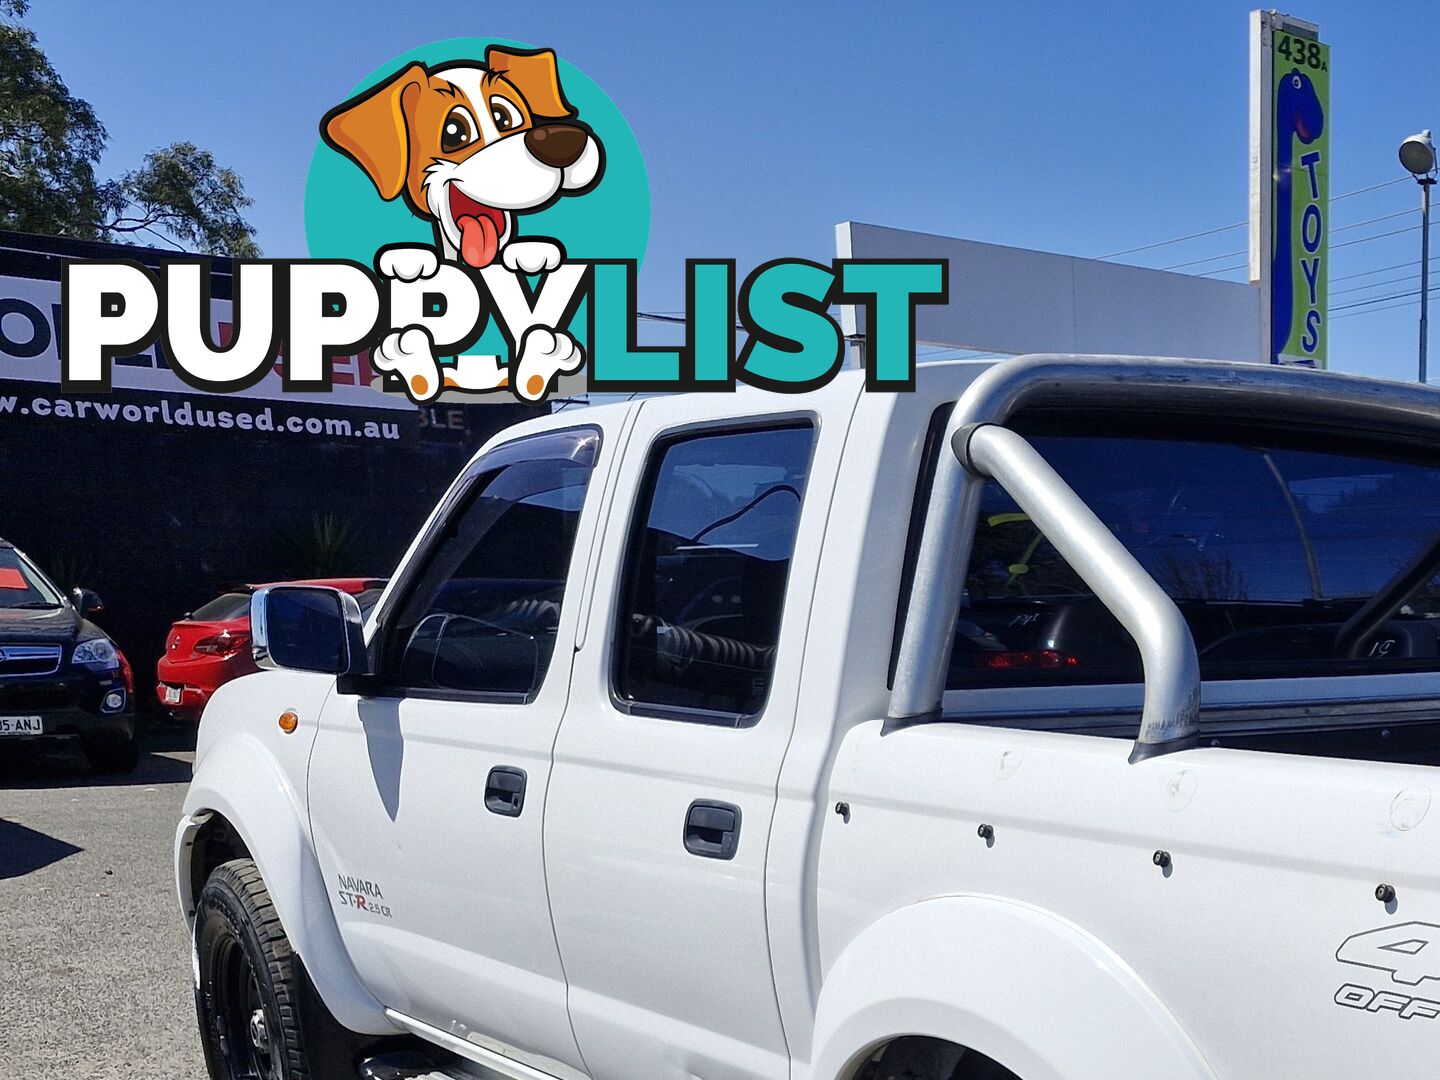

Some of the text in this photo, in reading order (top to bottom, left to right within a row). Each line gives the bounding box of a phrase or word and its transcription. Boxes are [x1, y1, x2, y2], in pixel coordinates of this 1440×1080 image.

[1277, 35, 1328, 73] 438A
[1300, 150, 1322, 354] TOYS
[338, 873, 384, 900] NAVARA
